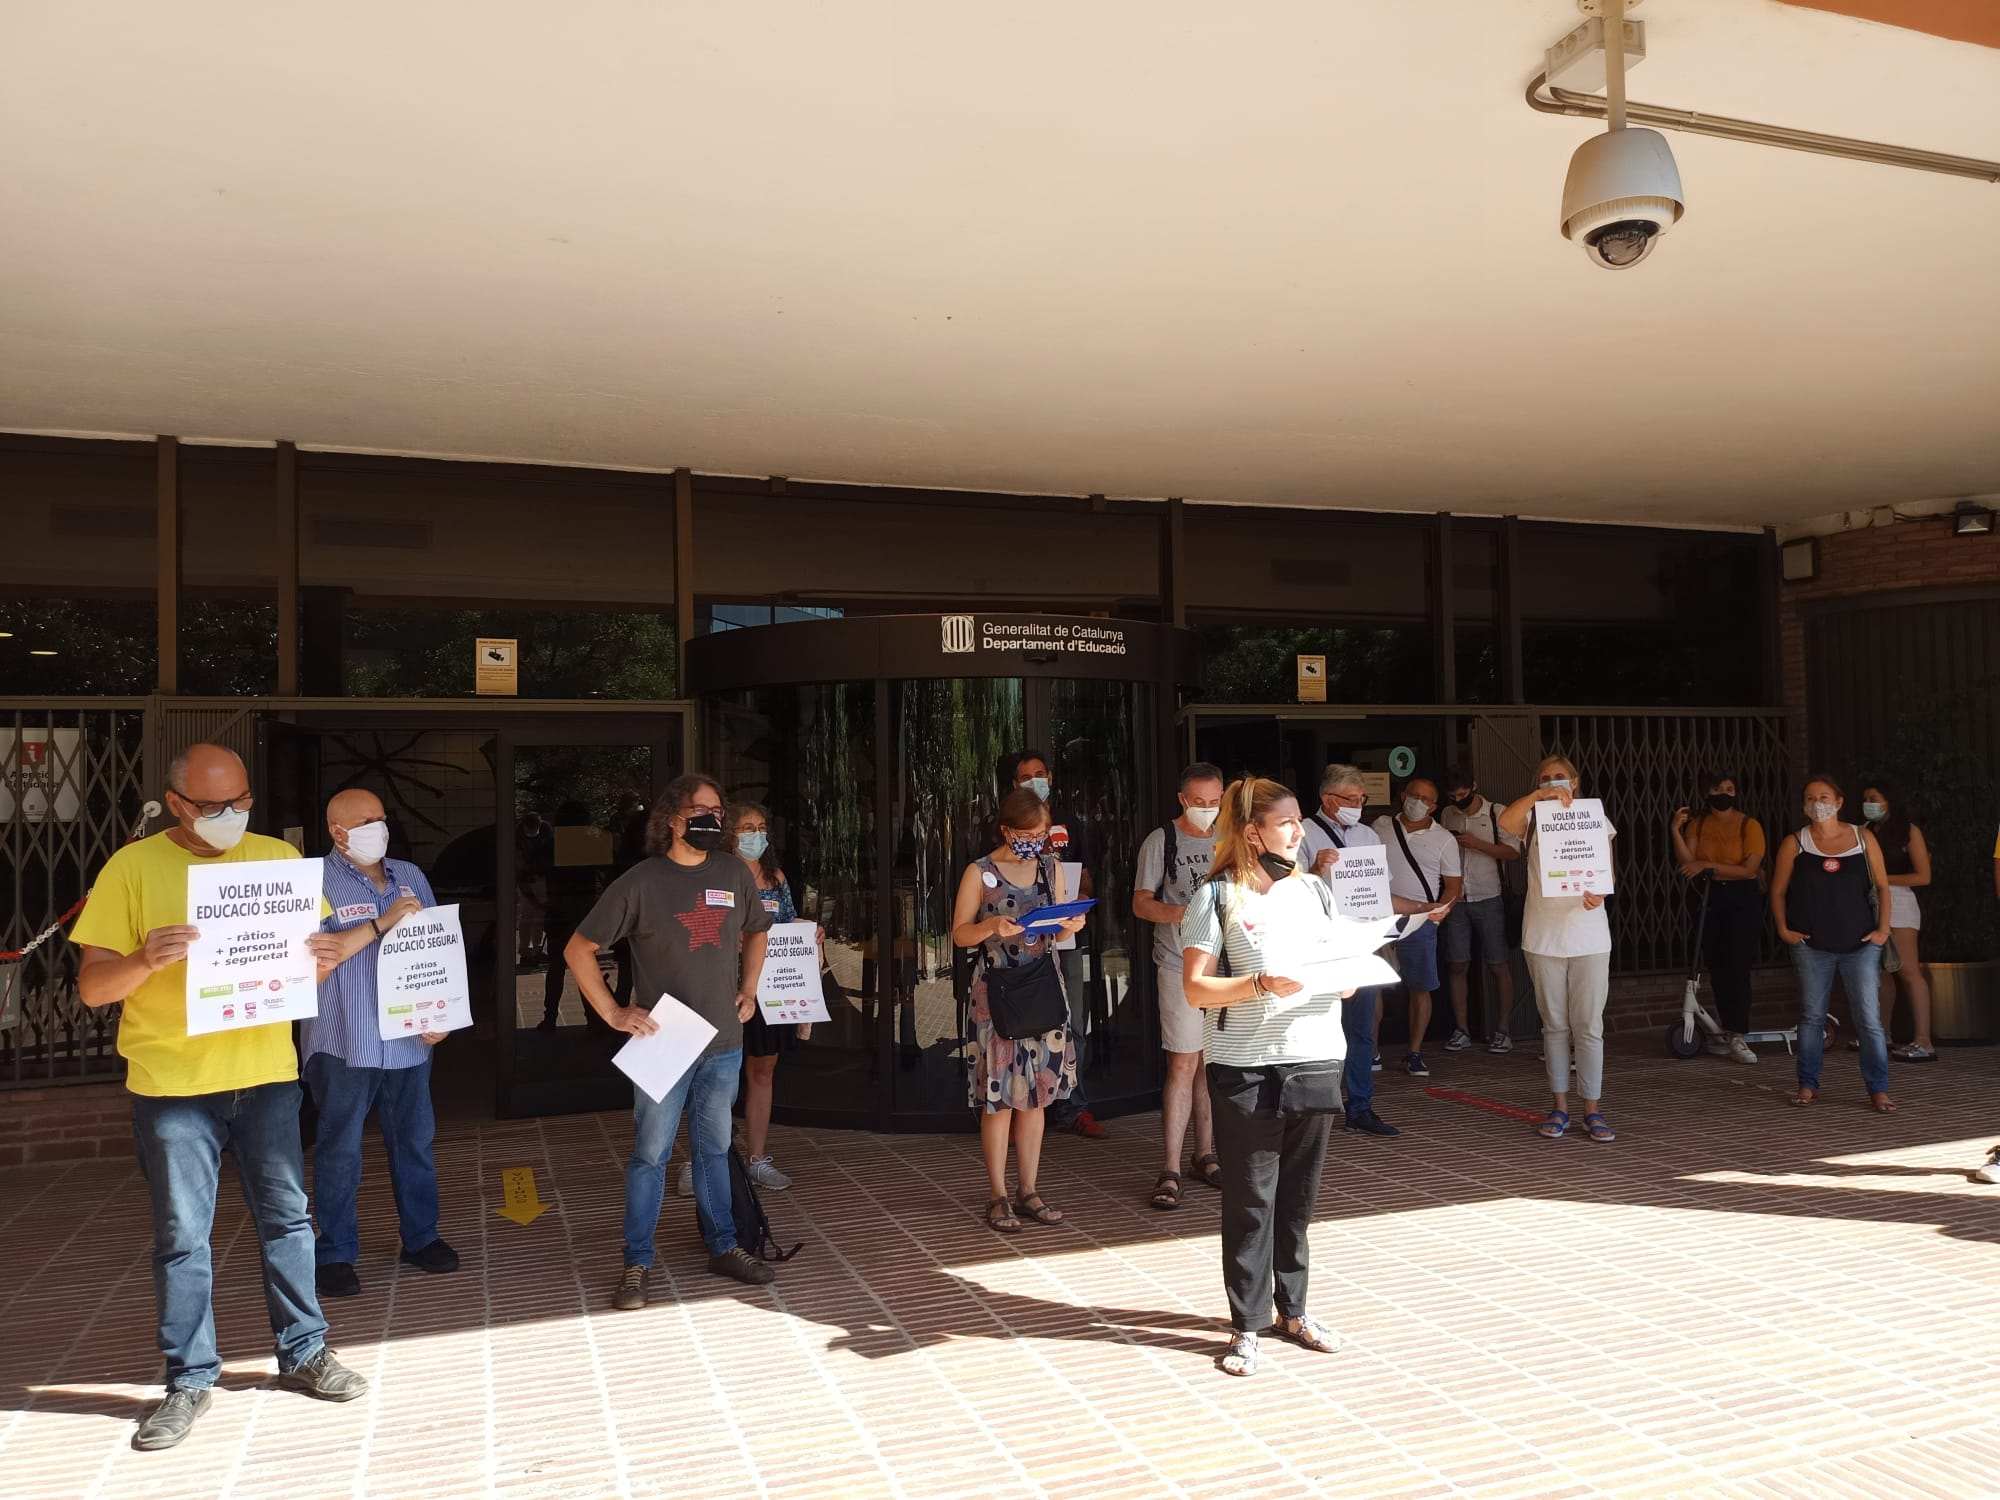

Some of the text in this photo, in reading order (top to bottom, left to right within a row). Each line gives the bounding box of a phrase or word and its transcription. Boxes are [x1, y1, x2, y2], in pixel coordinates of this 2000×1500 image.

[983, 622, 1124, 643] Generalitat de Catalunya
[983, 637, 1126, 655] Departament d'Educació
[1552, 811, 1590, 821] VOLEM UNA
[1561, 846, 1593, 854] personal
[1177, 854, 1209, 866] LACK
[1344, 858, 1376, 868] VOLEM UNA
[219, 881, 293, 900] VOLEM UNA
[1351, 892, 1377, 901] personal
[196, 897, 314, 919] EDUCACIÓ SEGURA!
[1350, 899, 1378, 907] seguretat
[237, 930, 276, 942] ràtios
[396, 922, 445, 939] VOLEM UNA
[383, 933, 458, 955] EDUCACIÓ SEGURA!
[767, 935, 804, 947] VOLEM UNA
[229, 939, 288, 956] personal
[789, 947, 815, 957] SEGURA!
[225, 950, 288, 966] seguretat
[411, 960, 437, 971] ràtios
[406, 967, 446, 982] personal
[773, 974, 804, 983] personal
[404, 976, 448, 990] seguretat
[772, 981, 806, 990] seguretat
